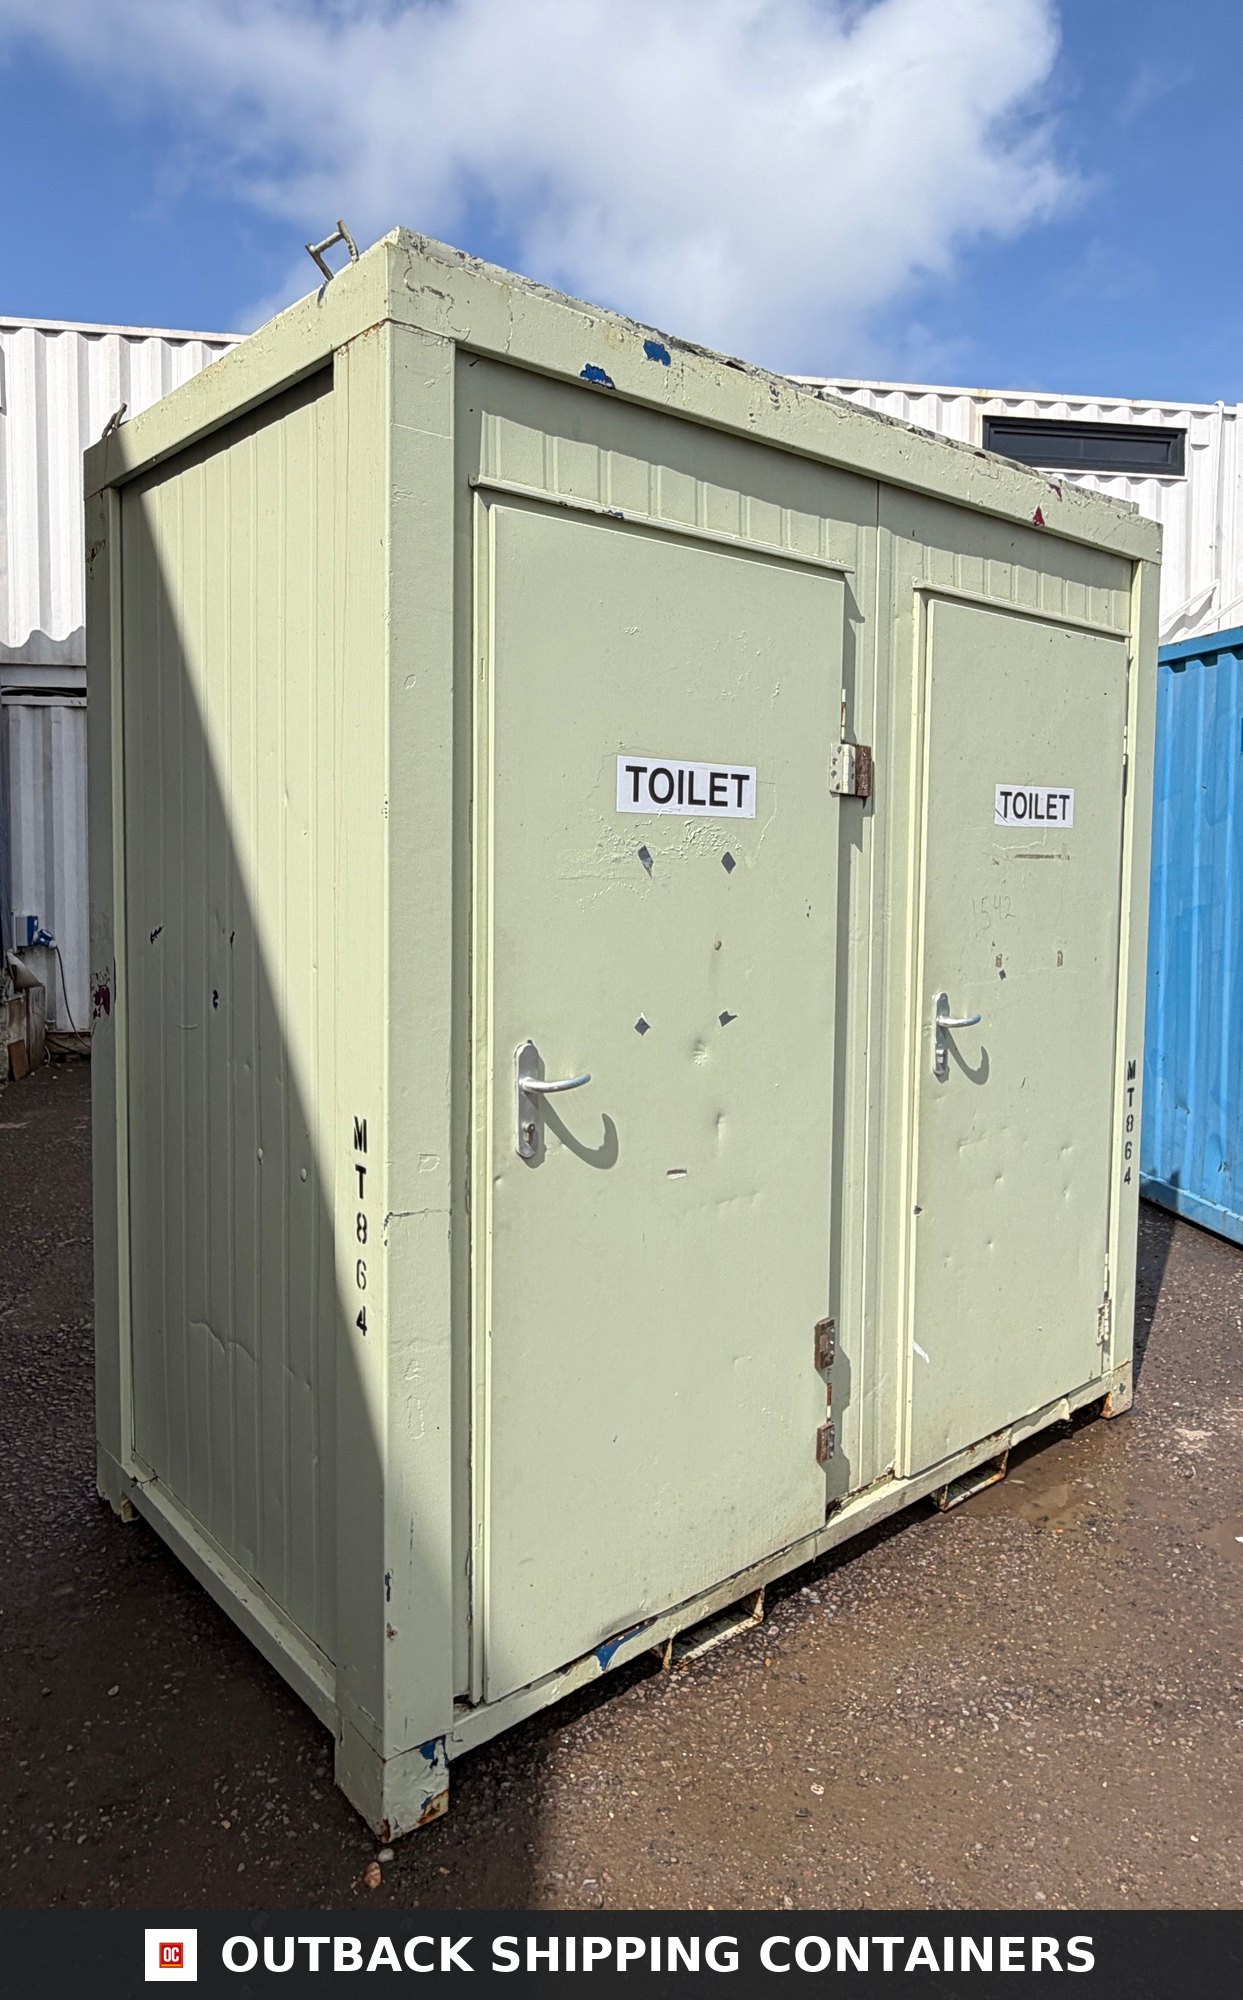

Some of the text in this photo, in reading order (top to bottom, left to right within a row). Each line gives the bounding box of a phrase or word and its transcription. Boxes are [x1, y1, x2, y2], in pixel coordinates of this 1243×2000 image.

[625, 765, 750, 808] TOILET
[999, 790, 1071, 821] TOILET
[1123, 1059, 1137, 1185] MT864
[353, 1115, 368, 1337] MT864
